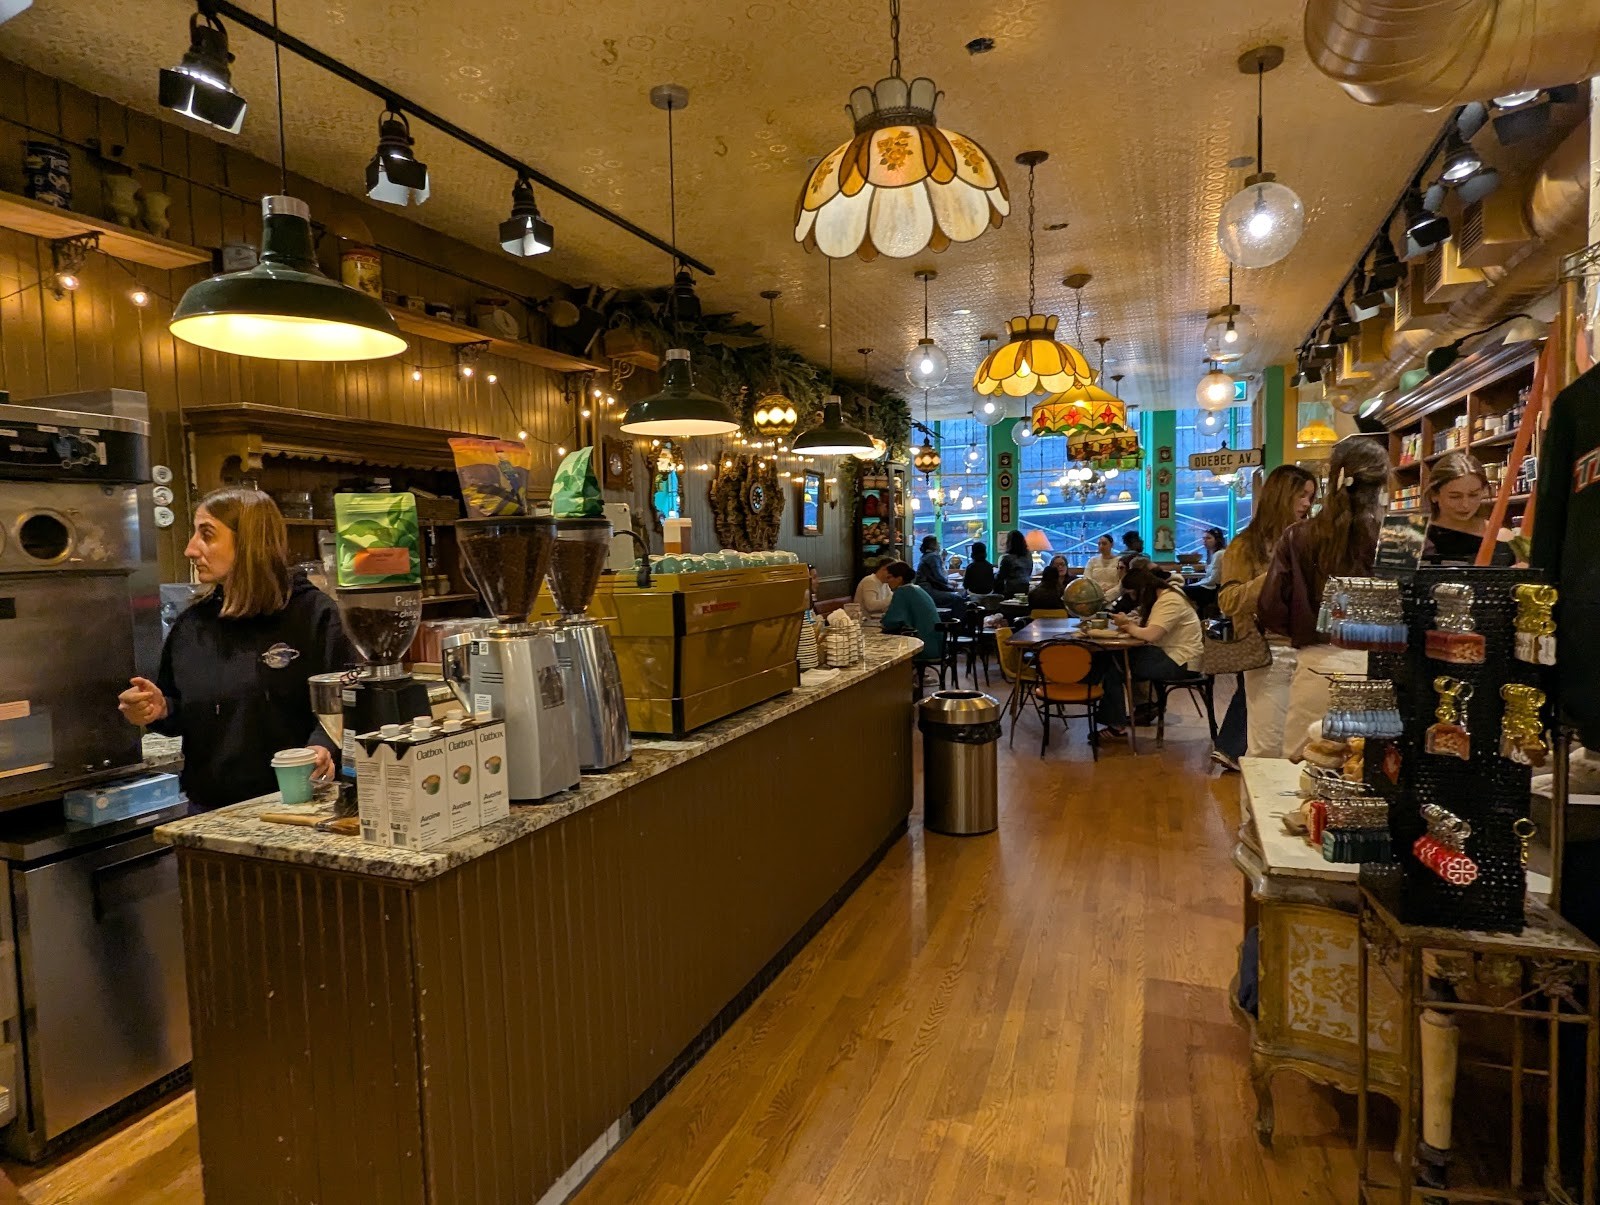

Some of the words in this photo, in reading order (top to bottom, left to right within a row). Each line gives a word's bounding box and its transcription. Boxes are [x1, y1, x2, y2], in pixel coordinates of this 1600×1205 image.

[1194, 454, 1233, 467] QUEBEC
[1238, 452, 1256, 464] AV.
[480, 731, 504, 742] Oatbox
[448, 739, 474, 751] Oatbox
[416, 747, 443, 760] Oatbox
[483, 790, 502, 800] Avoine
[452, 800, 471, 811] Avoine
